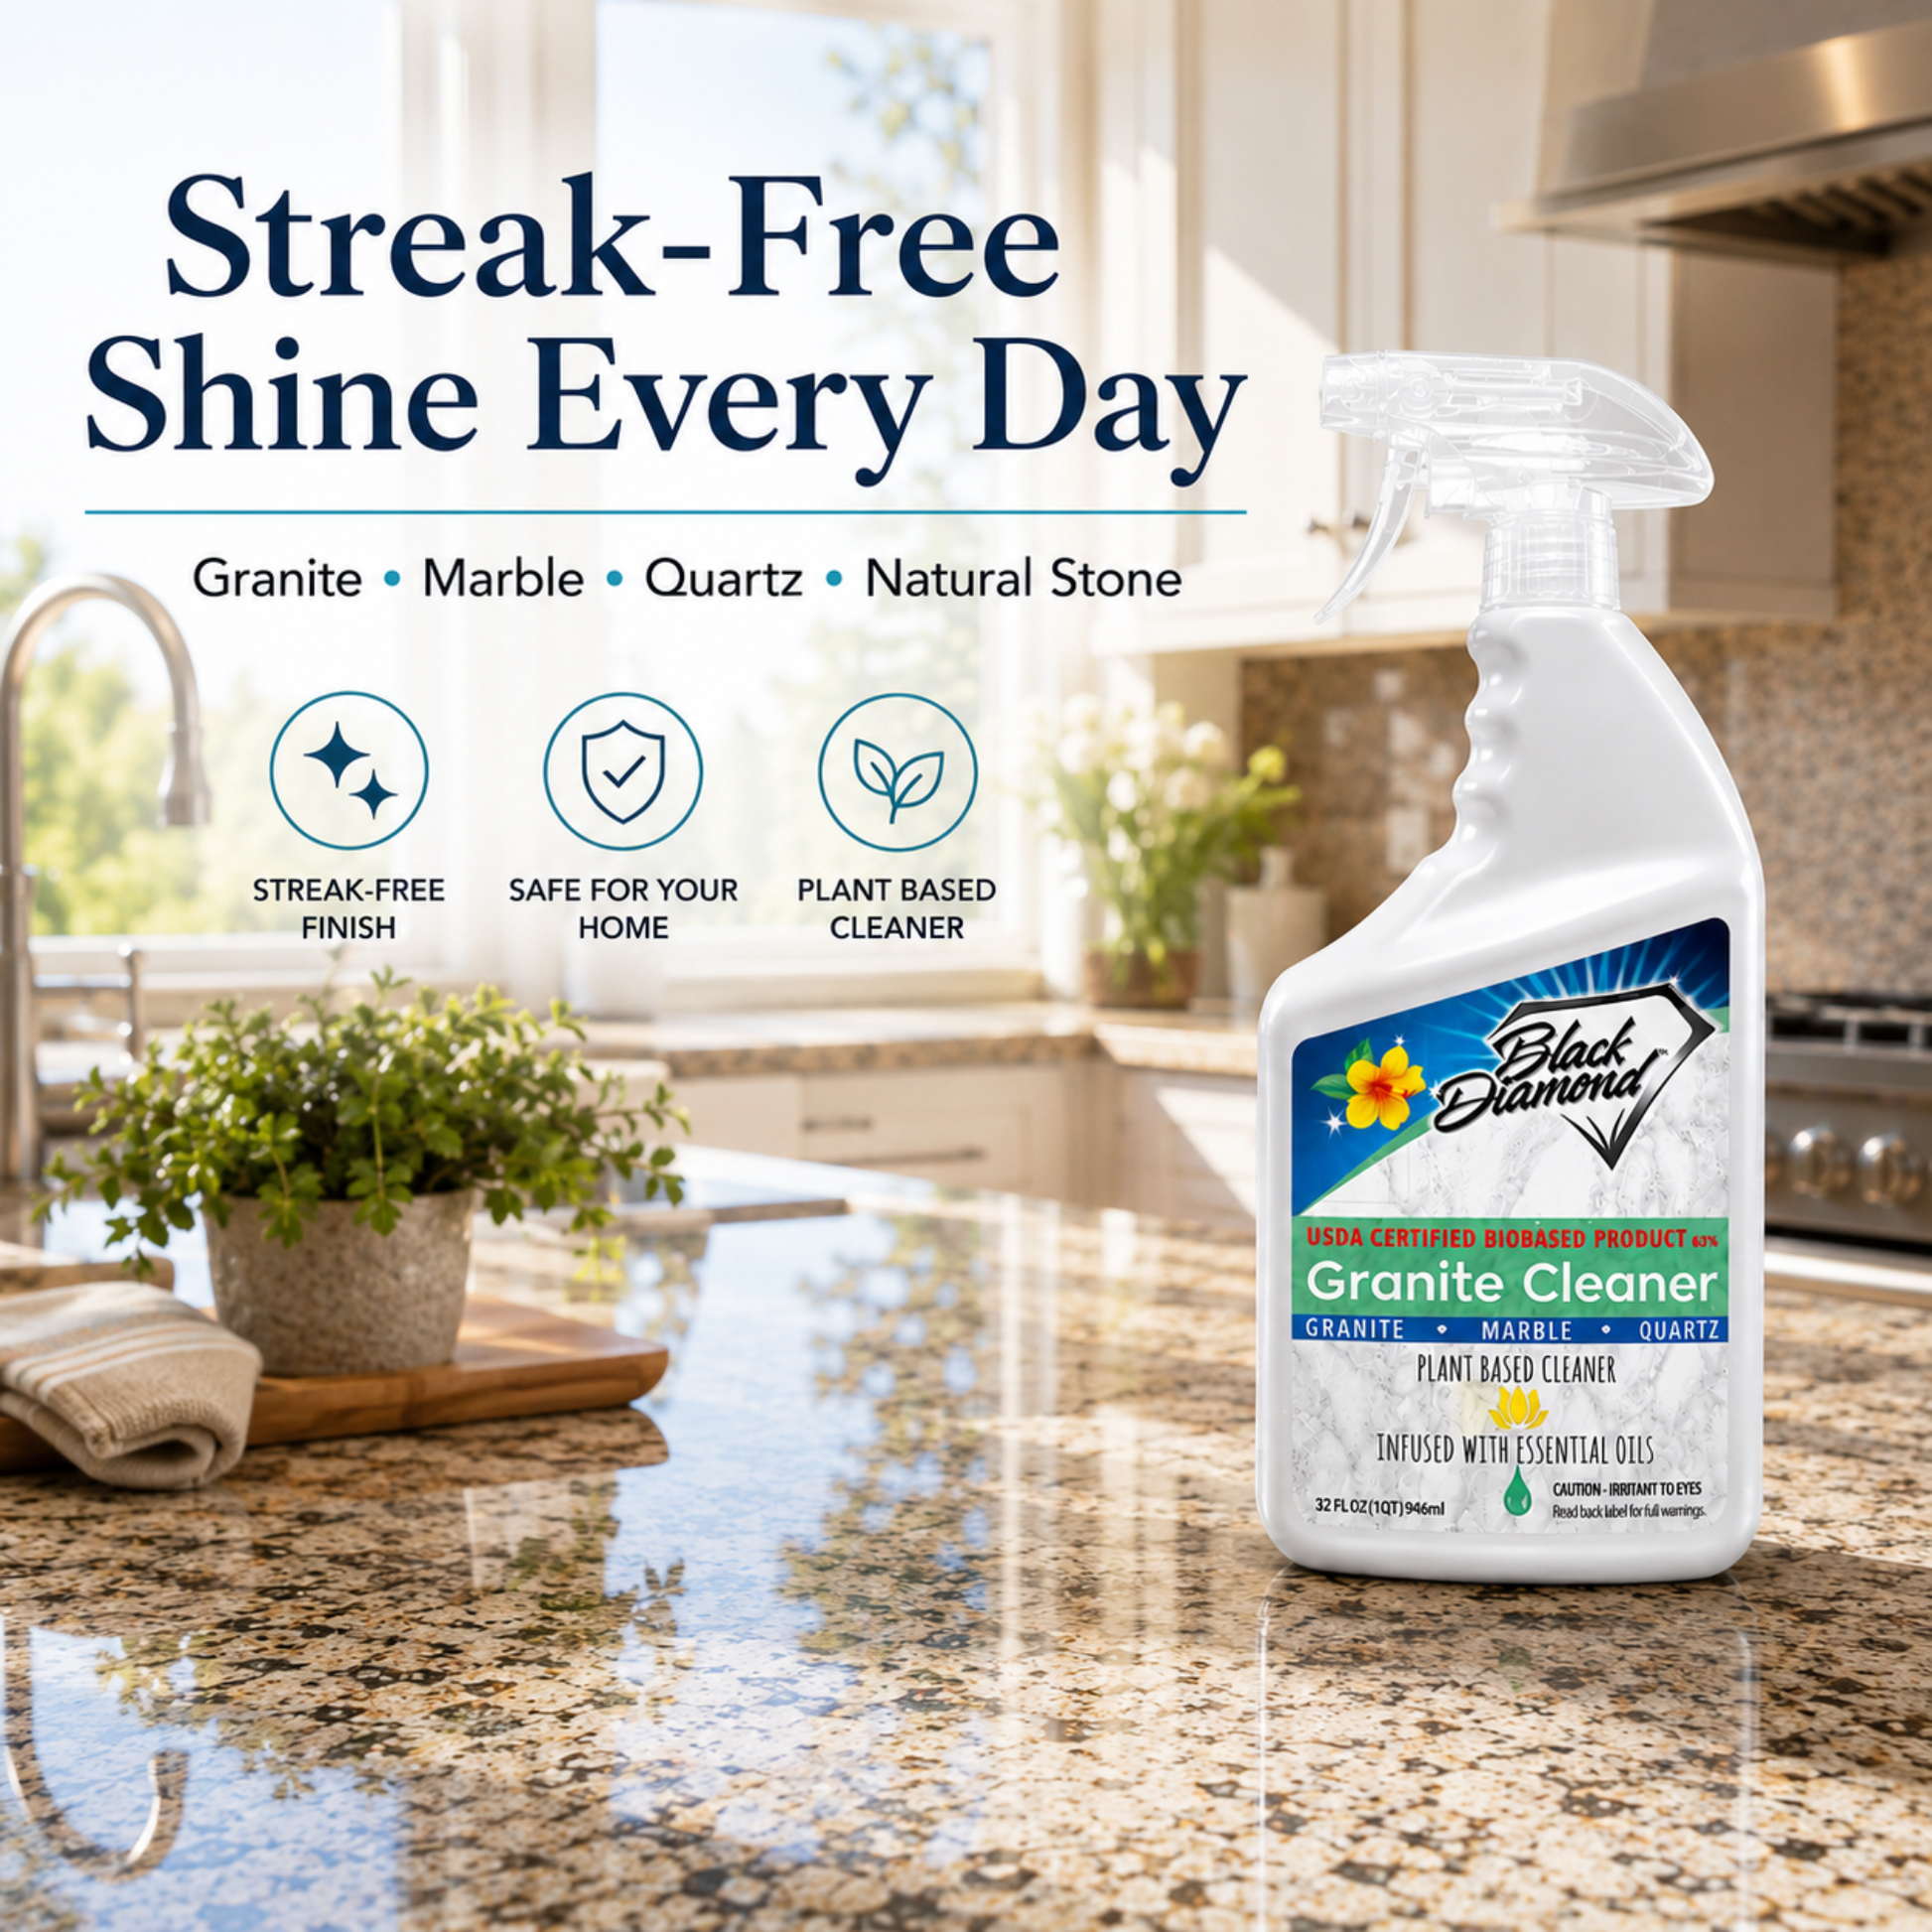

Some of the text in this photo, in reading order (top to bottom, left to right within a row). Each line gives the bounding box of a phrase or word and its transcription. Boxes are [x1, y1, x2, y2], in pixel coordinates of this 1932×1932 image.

[1491, 1016, 1636, 1081] Black
[1434, 1047, 1660, 1134] Diamond
[1307, 1226, 1363, 1247] USDA
[1369, 1227, 1476, 1249] CERTIFIED
[1484, 1228, 1587, 1249] BIOBASED
[1593, 1228, 1687, 1249] PRODUCT
[1307, 1259, 1719, 1303] Granite Cleaner
[1305, 1317, 1720, 1341] GRANITE MARBLE QUARTZ
[1417, 1353, 1616, 1383] PLANT BASED CLEANER
[1376, 1433, 1654, 1465] INFUSED WITH ESSENTIAL OILS
[1552, 1481, 1601, 1497] CAUTION
[1608, 1481, 1658, 1497] IRRITANT
[1660, 1481, 1675, 1496] TO
[1676, 1480, 1703, 1495] EYES
[1314, 1497, 1332, 1513] 32
[1333, 1498, 1348, 1513] FL
[1552, 1504, 1579, 1519] Read
[1580, 1504, 1603, 1519] back
[1604, 1504, 1628, 1519] label
[1629, 1503, 1643, 1518] for
[1644, 1503, 1660, 1518] full
